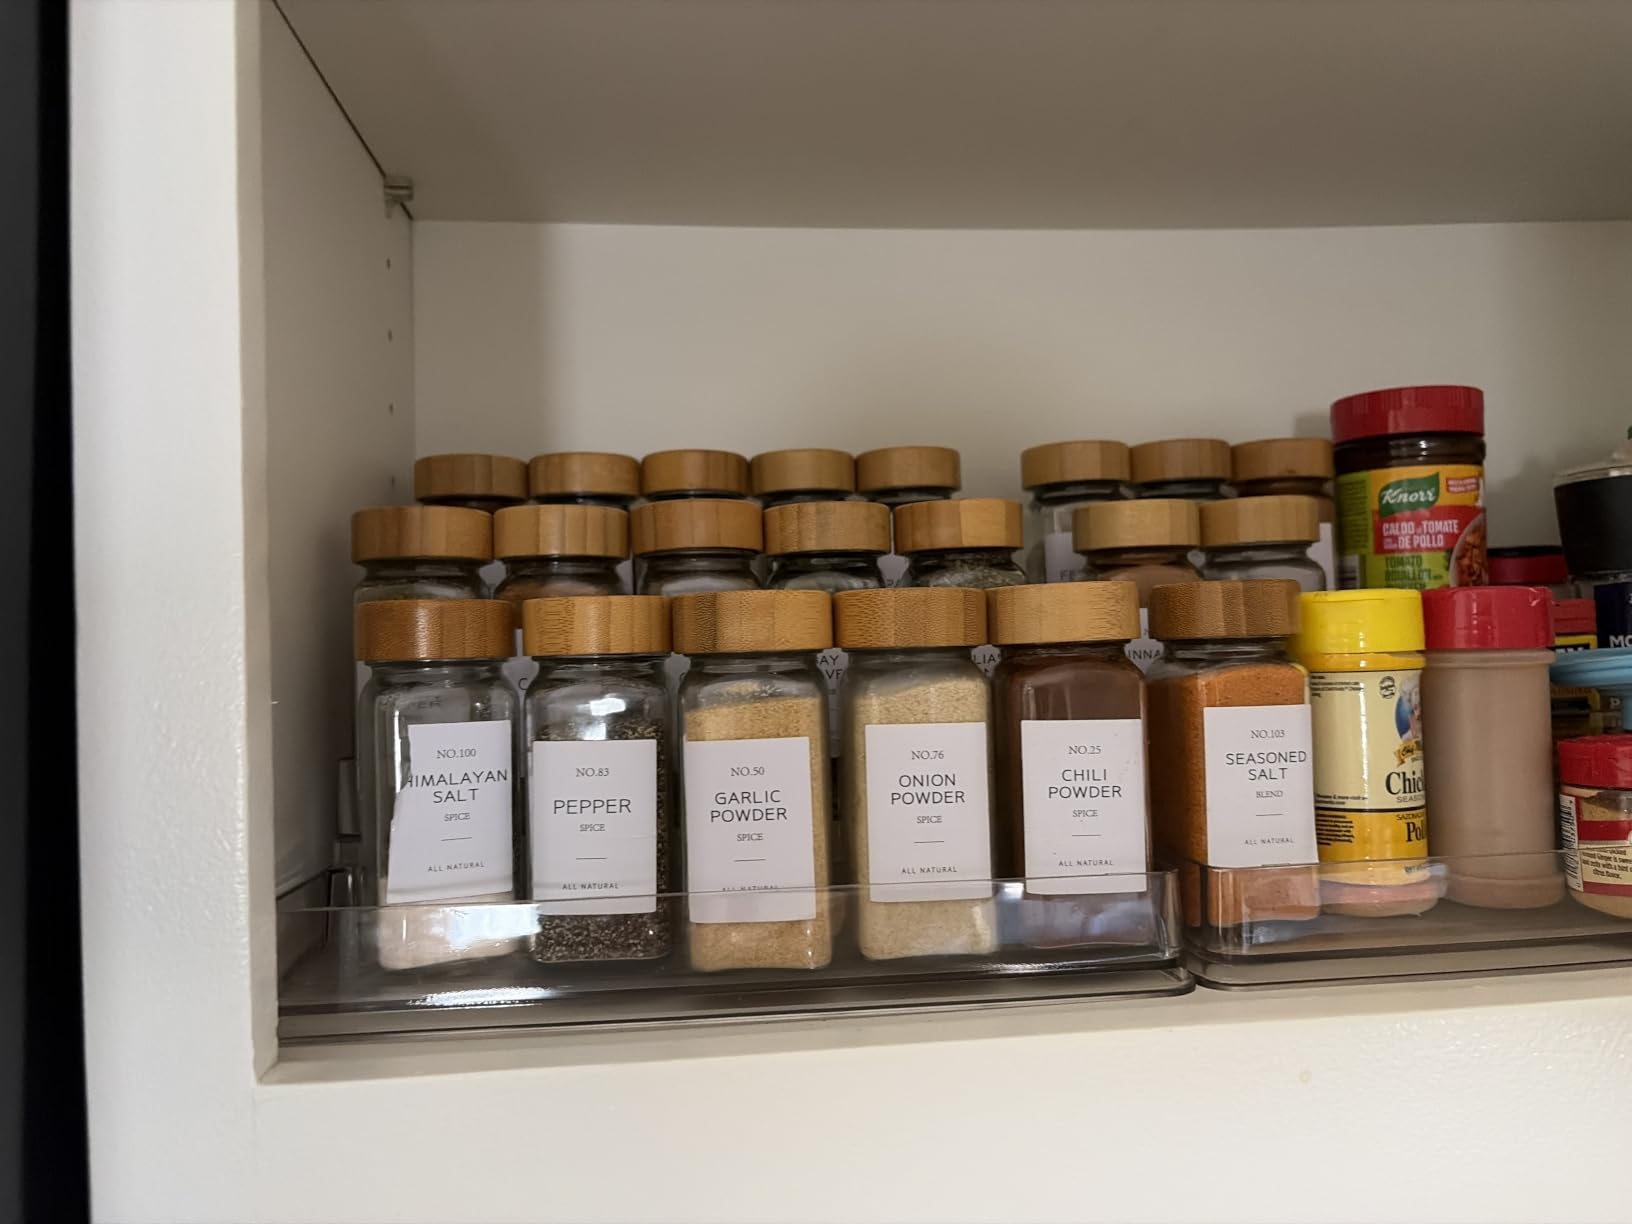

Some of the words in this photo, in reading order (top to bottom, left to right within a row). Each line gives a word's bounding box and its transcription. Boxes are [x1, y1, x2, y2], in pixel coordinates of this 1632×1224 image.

[1381, 489, 1436, 504] Knorr
[1383, 522, 1415, 536] CALDO
[1423, 520, 1459, 534] TOMATE
[1398, 537, 1411, 549] DE
[1413, 535, 1444, 548] POLLO
[1250, 729, 1285, 739] NO.103
[436, 748, 477, 760] NO.100
[911, 750, 944, 760] NO.76
[1068, 745, 1101, 755] NO.25
[1225, 750, 1307, 766] SEASONED
[575, 767, 610, 777] NO.83
[731, 765, 765, 776] NO.50
[1061, 769, 1107, 782] CHILI
[1248, 767, 1288, 781] SALT
[898, 774, 956, 788] ONION
[433, 788, 479, 804] SALT
[714, 789, 781, 805] GARLIC
[891, 790, 966, 805] POWDER
[1048, 785, 1122, 799] POWDER
[1256, 790, 1283, 798] BLEND
[553, 798, 632, 815] PEPPER
[444, 812, 471, 822] SPICE
[710, 807, 787, 823] POWDER
[1072, 809, 1098, 818] SPICE
[916, 815, 943, 824] SPICE
[579, 823, 606, 832] SPICE
[736, 832, 764, 842] SPICE
[1261, 836, 1295, 844] NATURAL
[427, 863, 444, 872] ALL
[446, 861, 485, 871] NATURAL
[901, 867, 917, 875] ALL
[580, 882, 620, 890] NATURAL
